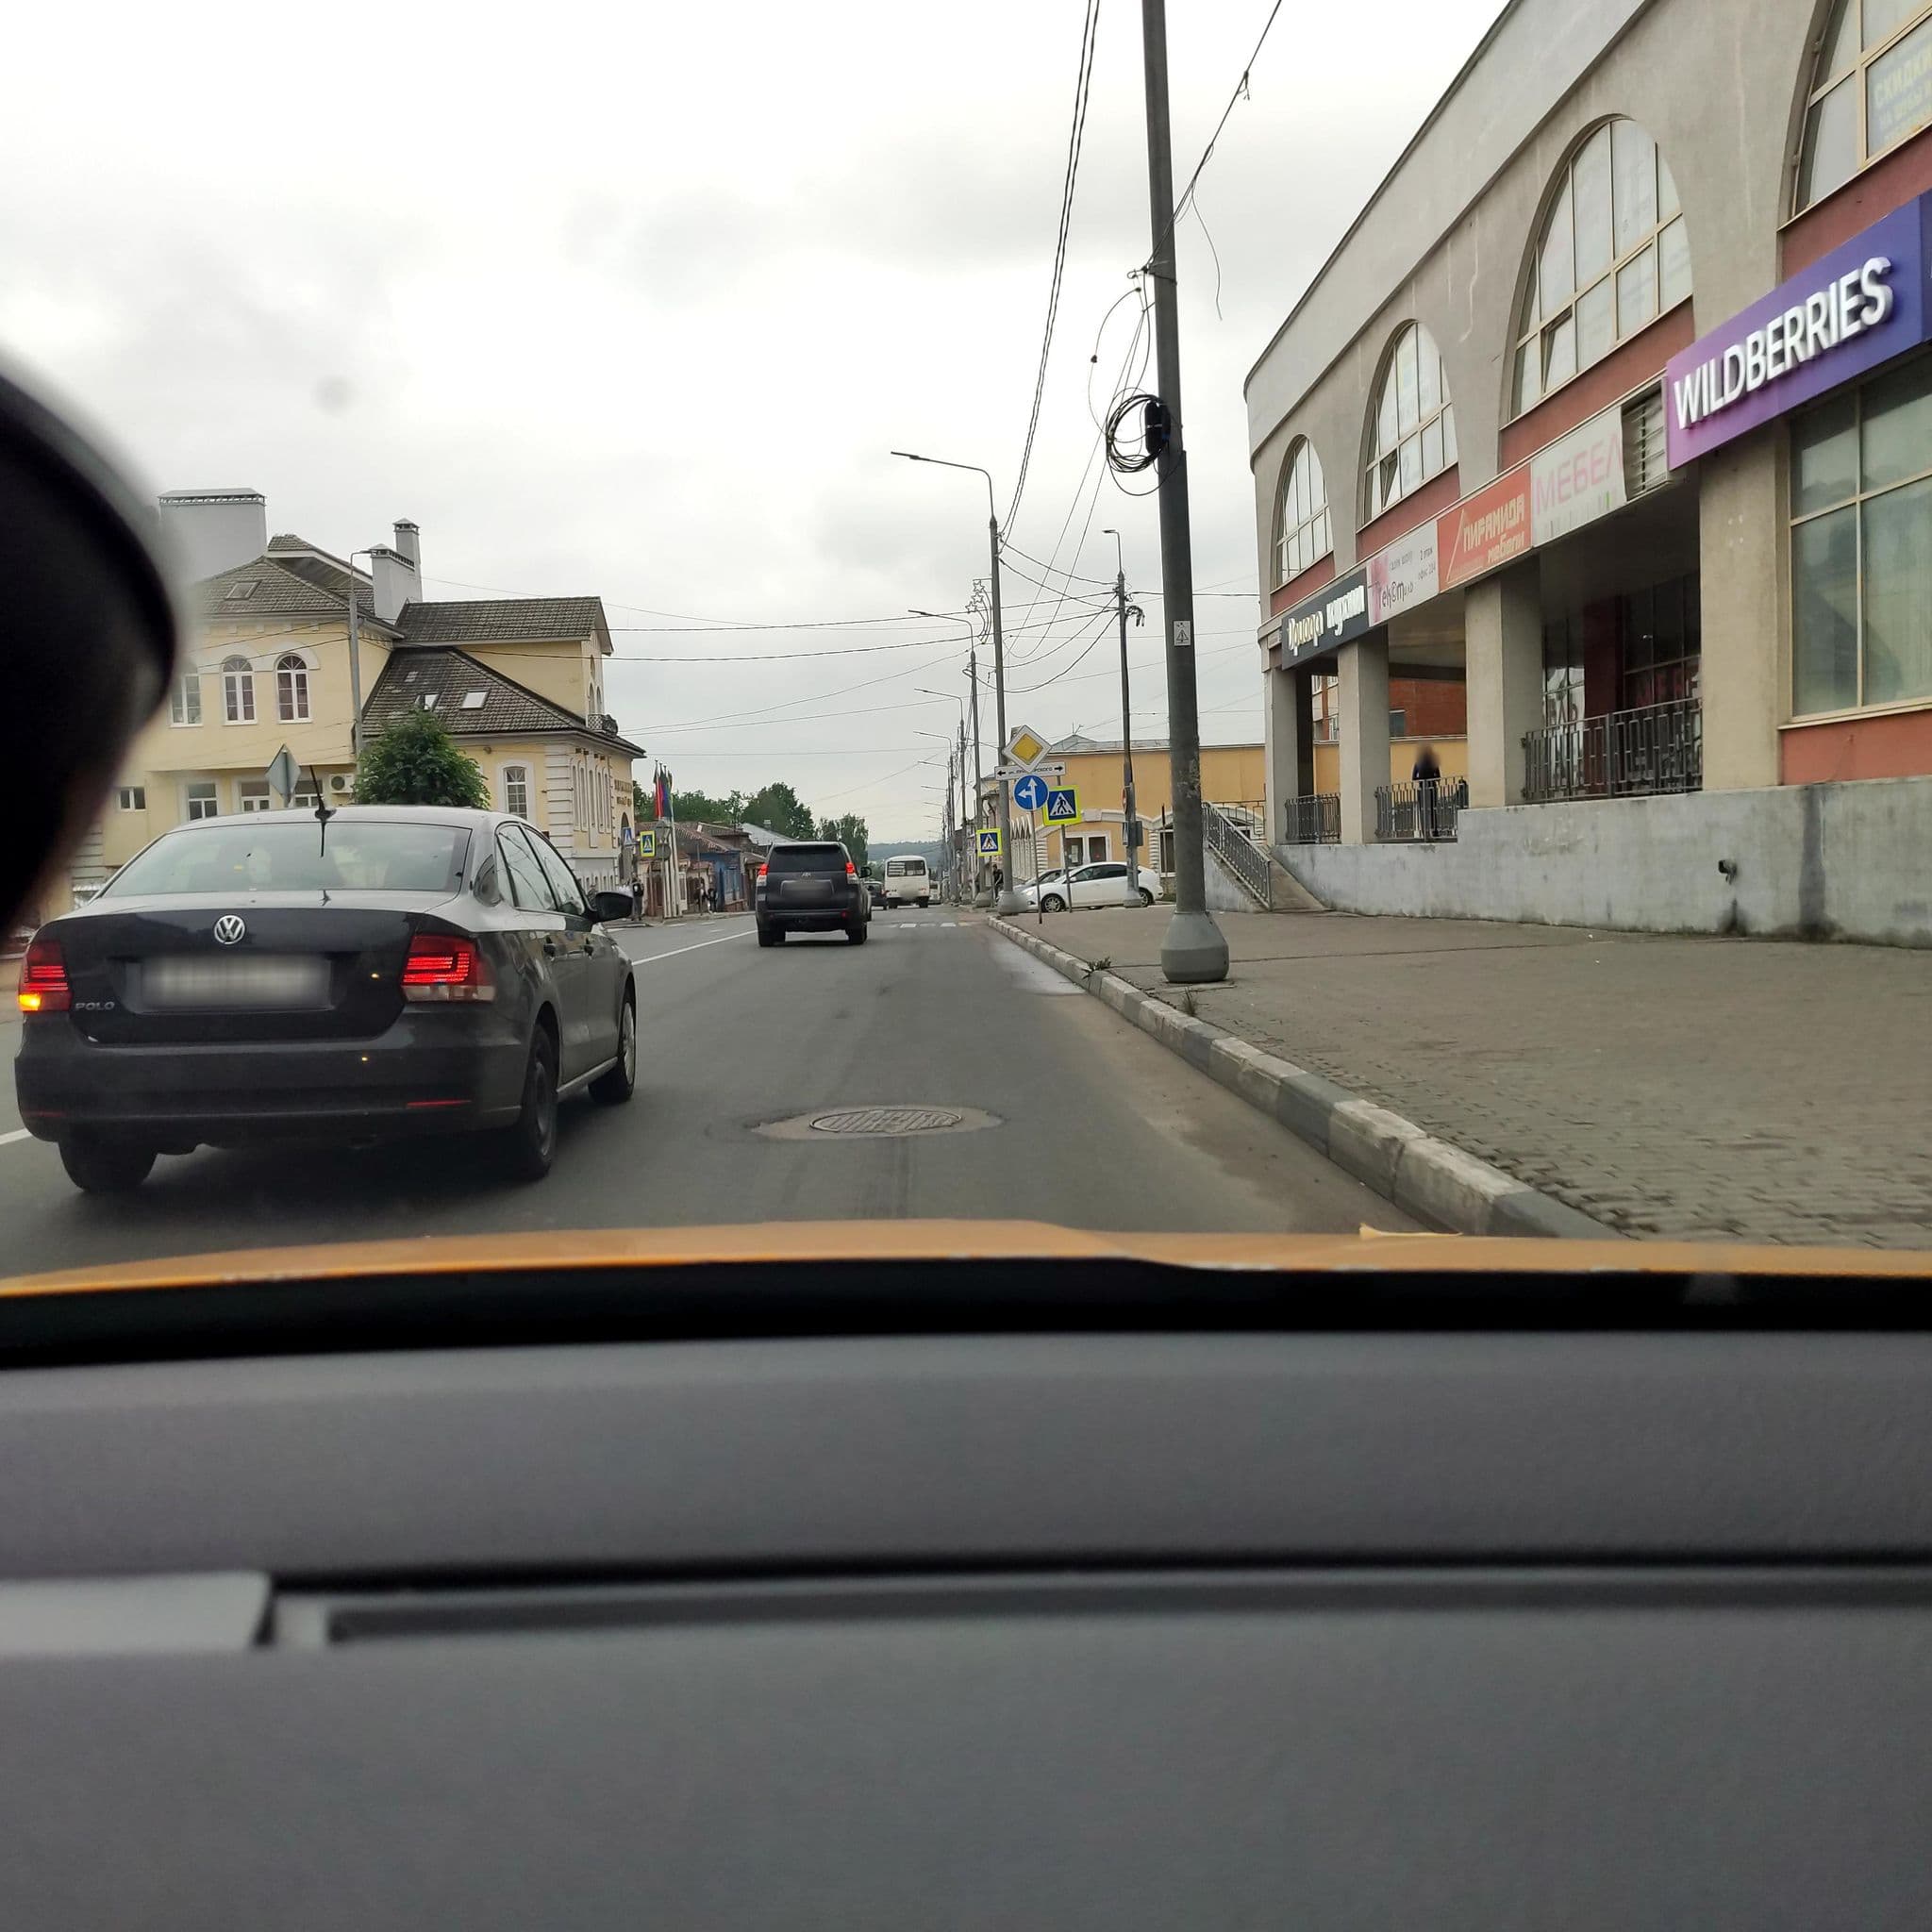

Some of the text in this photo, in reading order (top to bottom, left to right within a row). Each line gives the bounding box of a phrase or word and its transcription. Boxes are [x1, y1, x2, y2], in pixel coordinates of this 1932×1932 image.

[1674, 257, 1893, 430] WILDBERRIES
[1463, 493, 1524, 554] ПИРАМИДА
[75, 1001, 115, 1011] POLO
